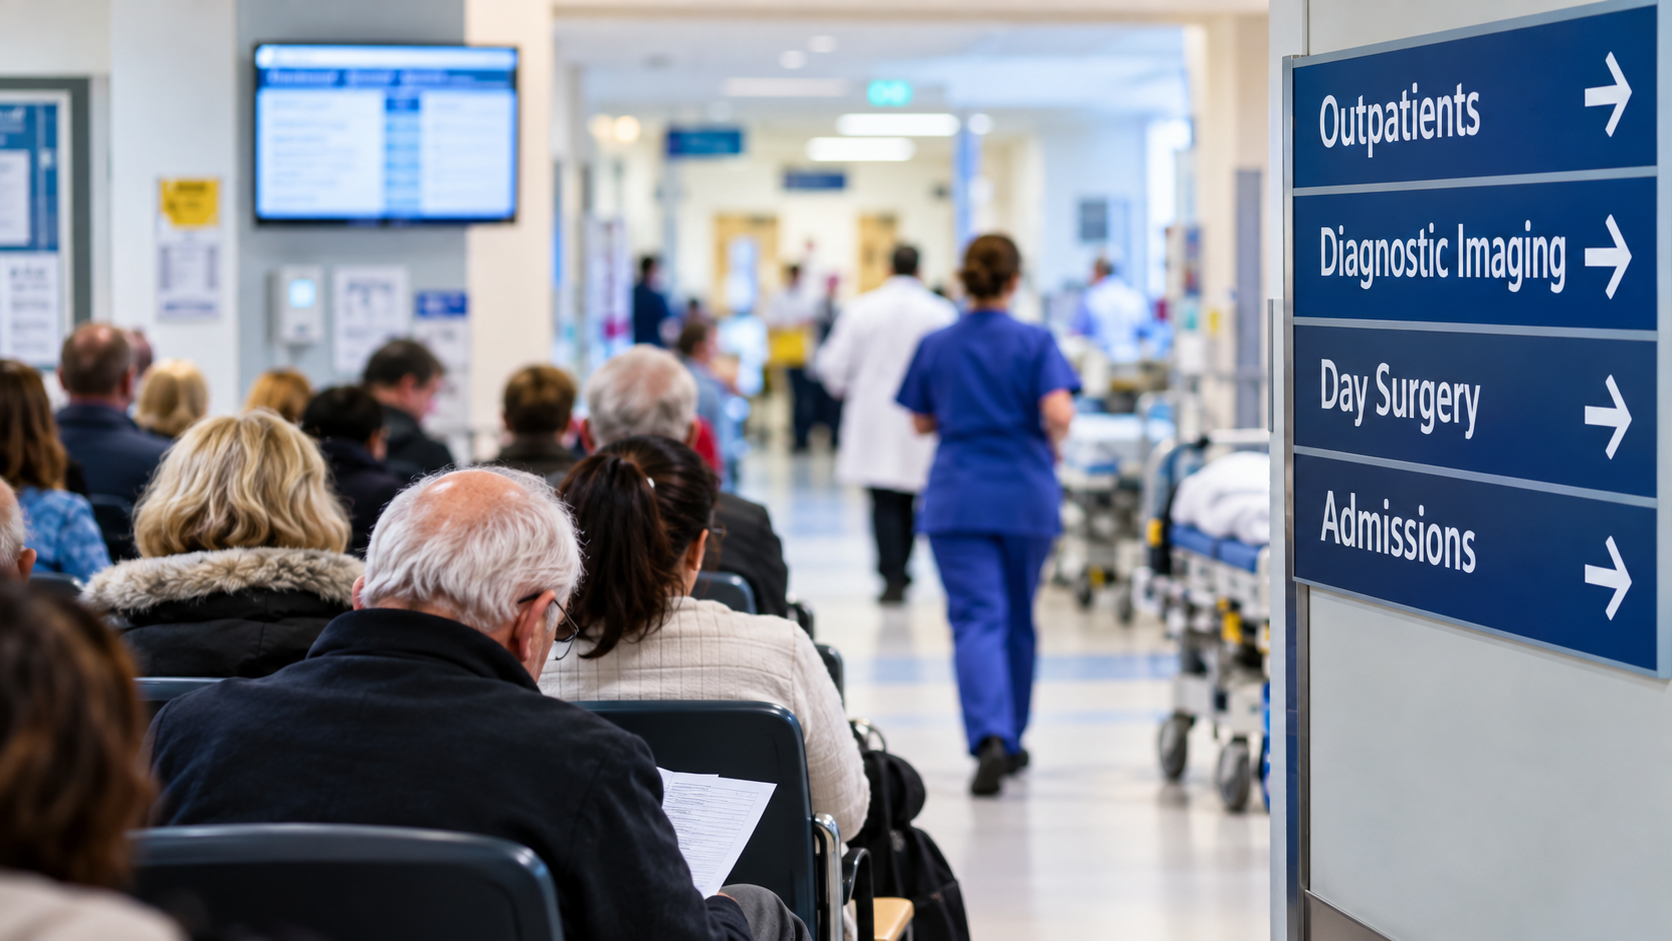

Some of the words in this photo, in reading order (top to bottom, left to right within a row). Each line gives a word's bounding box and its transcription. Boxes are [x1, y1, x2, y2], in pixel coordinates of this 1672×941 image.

[1319, 82, 1481, 158] Outpatients
[1320, 222, 1449, 290] Diagnostic
[1458, 219, 1567, 294] Imaging
[1321, 358, 1369, 427] Day
[1376, 362, 1481, 440] Surgery
[1320, 490, 1477, 574] Admissions
